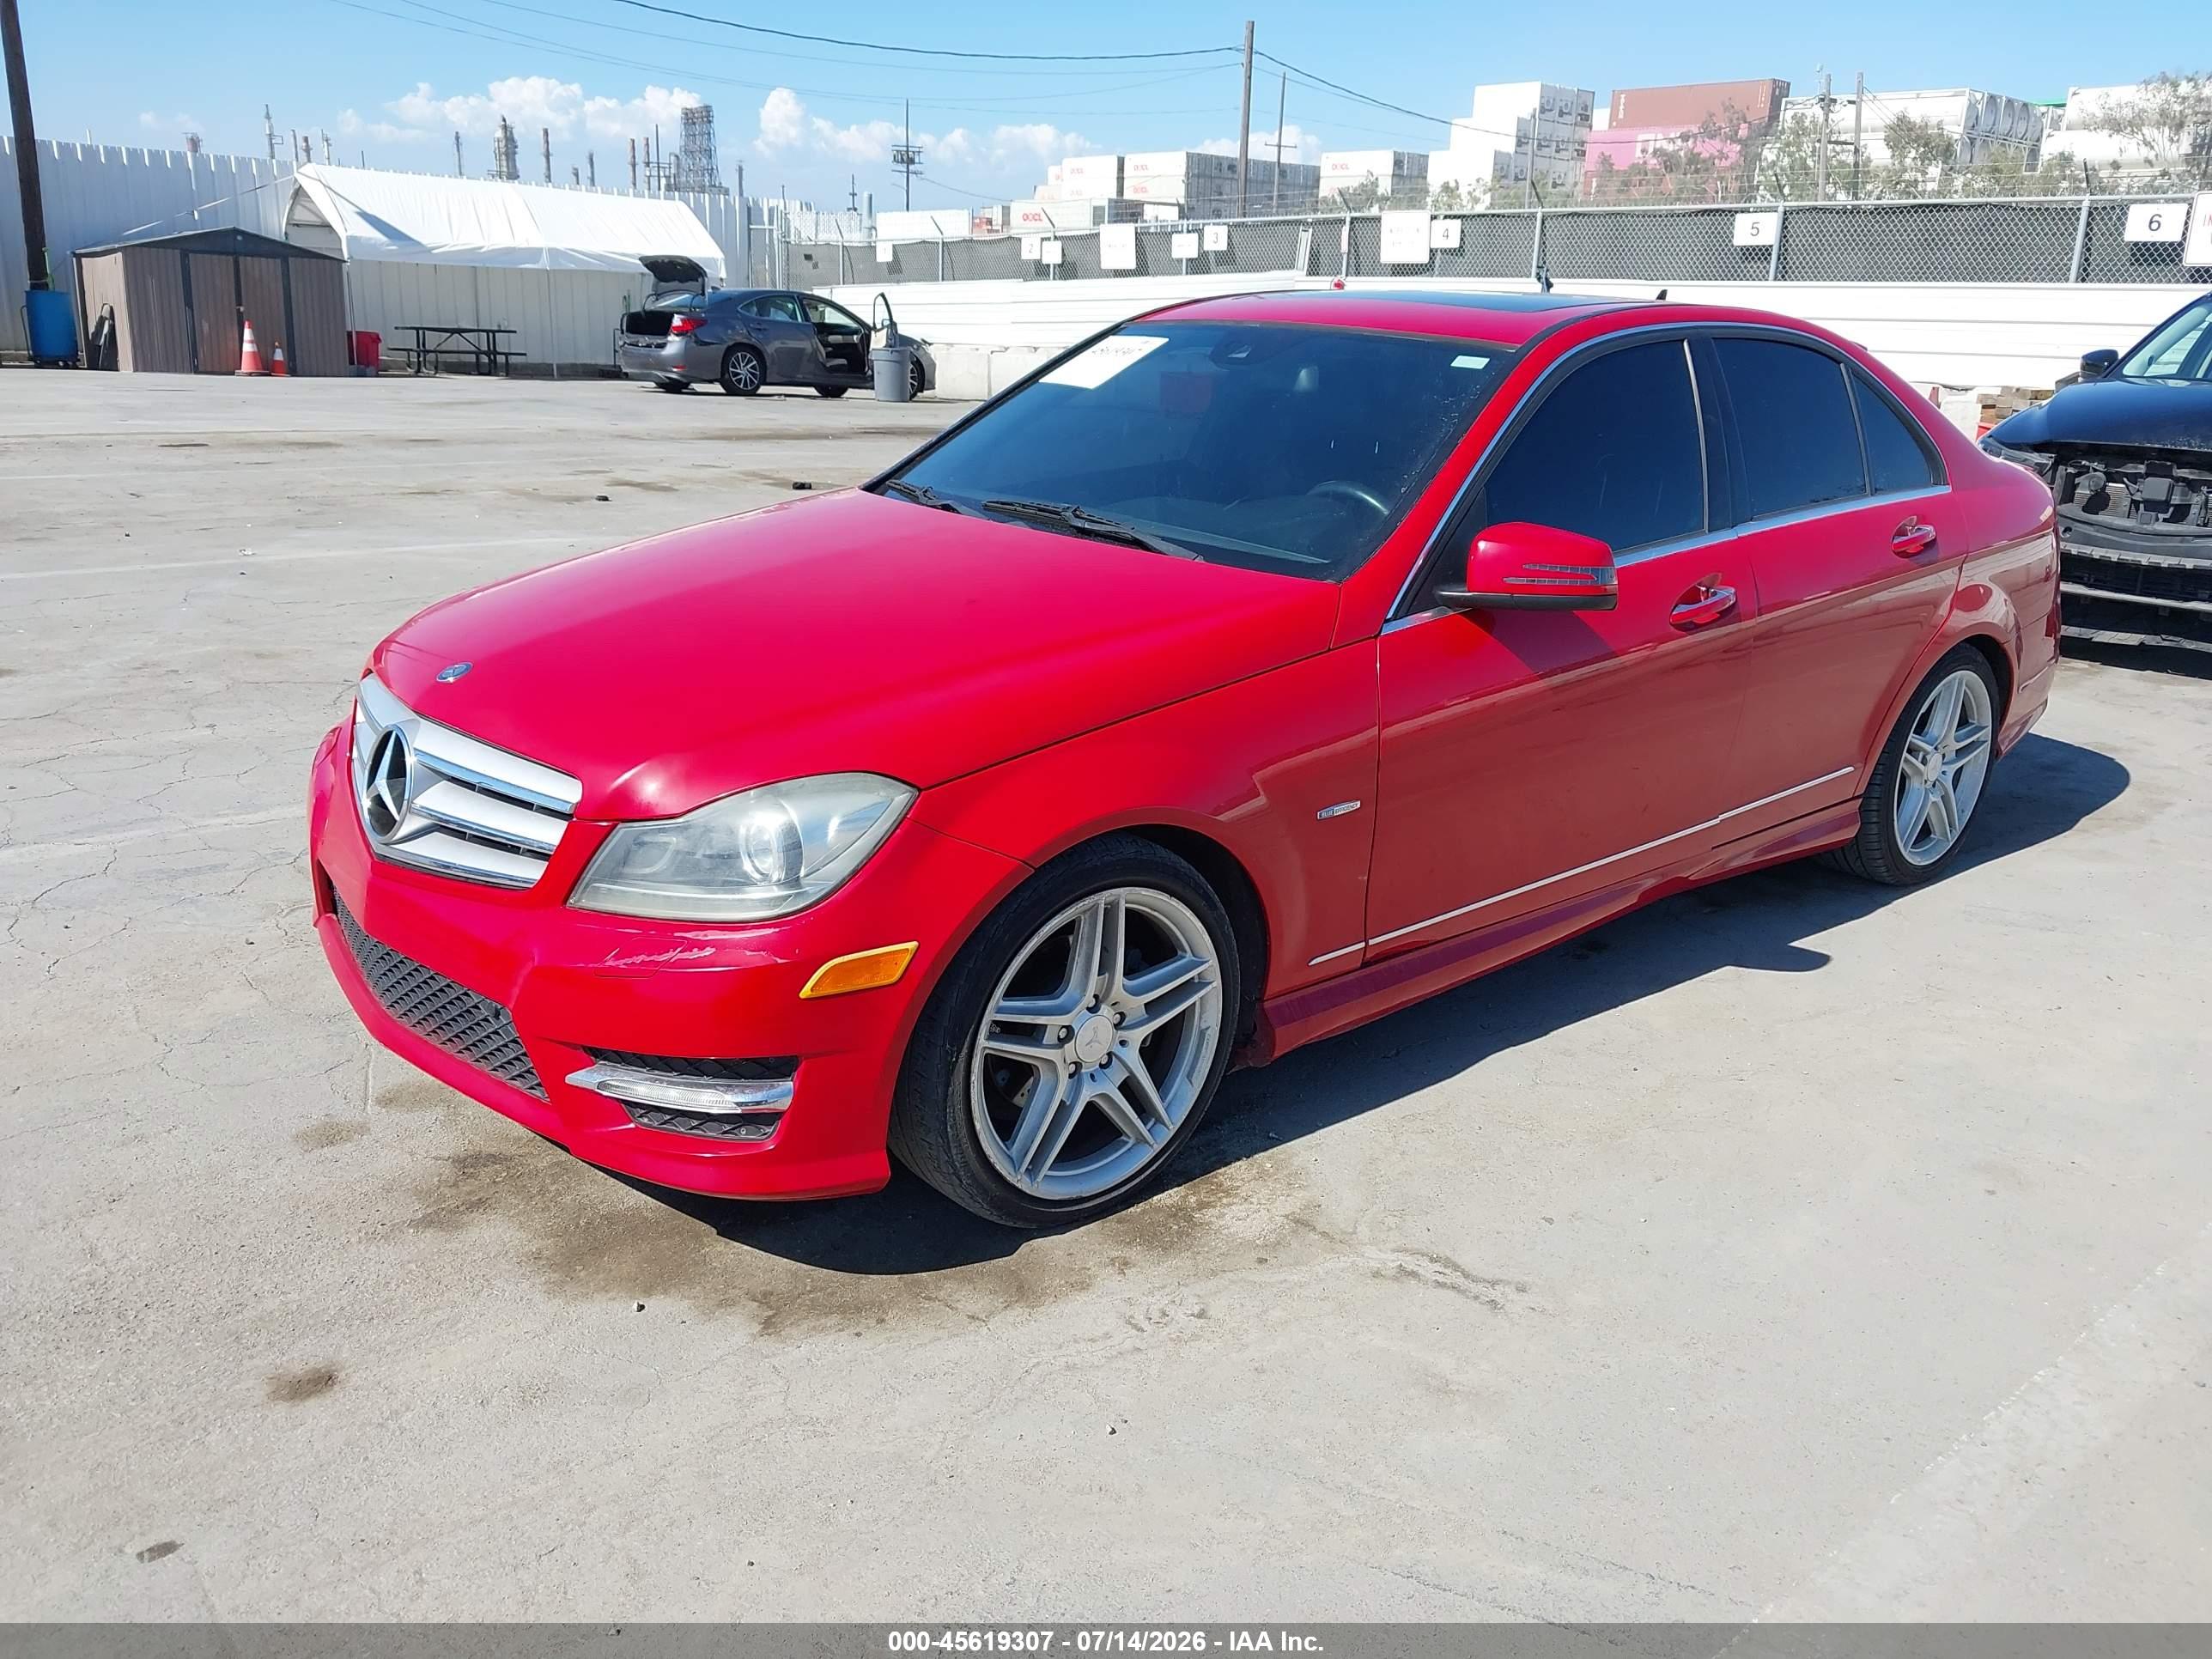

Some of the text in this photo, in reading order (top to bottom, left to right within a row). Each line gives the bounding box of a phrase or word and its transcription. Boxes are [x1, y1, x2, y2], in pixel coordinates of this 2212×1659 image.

[1750, 222, 1760, 236] 5
[2148, 213, 2162, 232] 6
[1212, 232, 1218, 244] 3
[1442, 228, 1449, 240] 4
